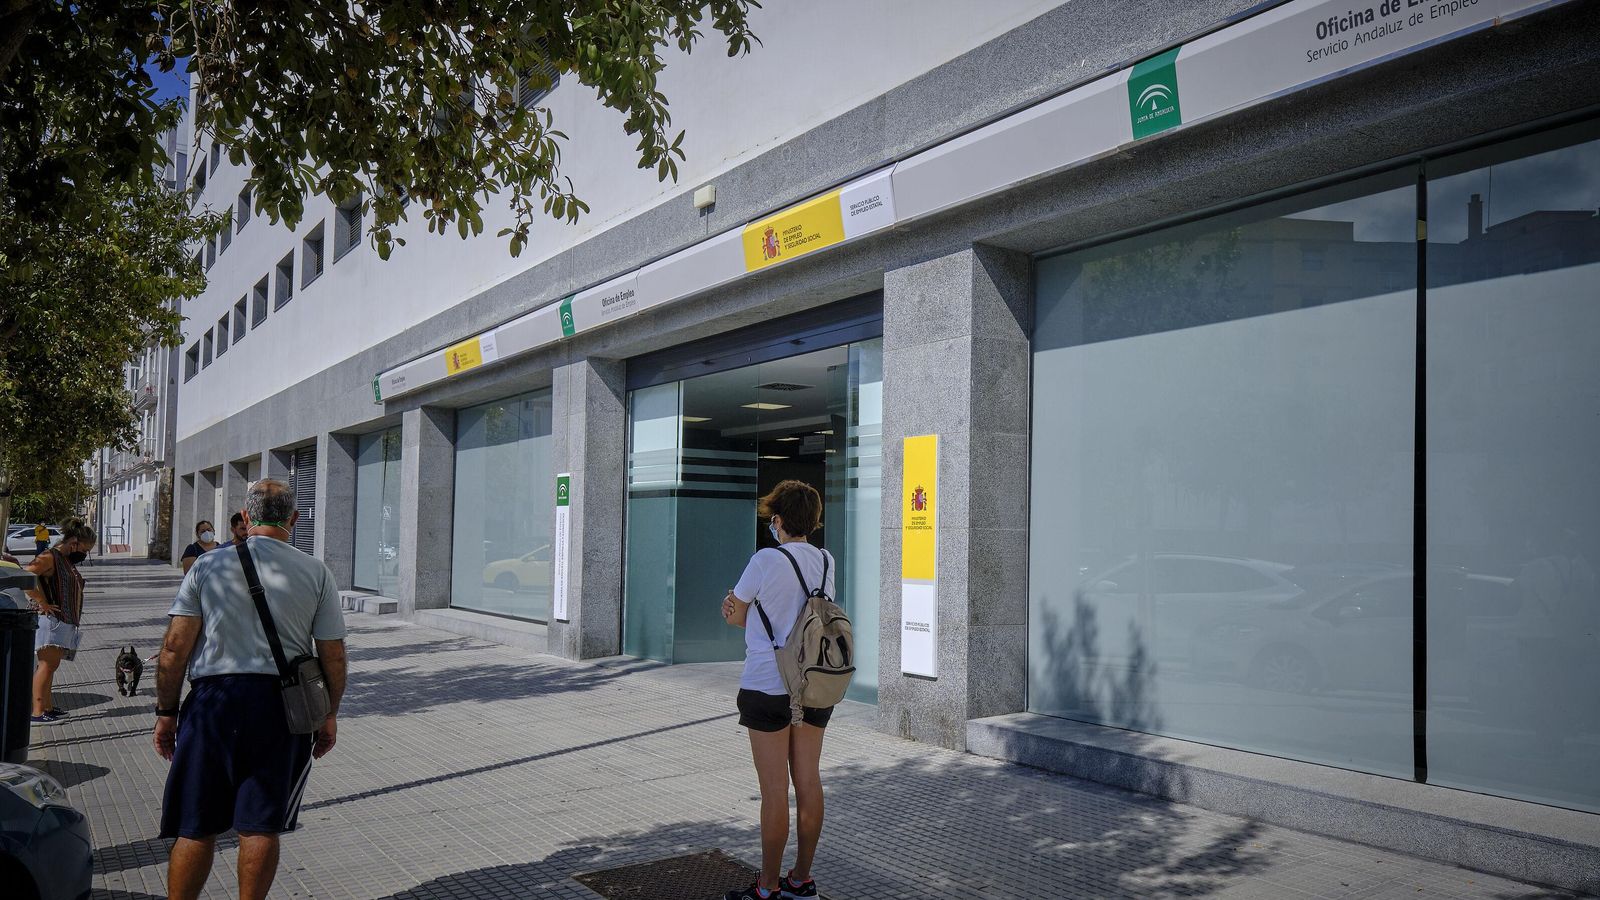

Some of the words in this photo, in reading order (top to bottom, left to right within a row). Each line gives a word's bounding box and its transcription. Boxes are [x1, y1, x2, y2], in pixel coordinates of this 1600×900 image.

[1306, 39, 1349, 63] Servicio
[1353, 19, 1403, 47] Andaluz
[1408, 12, 1424, 27] de
[1315, 7, 1375, 40] Oficina
[1379, 0, 1401, 18] de
[602, 297, 615, 307] Oficina
[620, 290, 634, 300] Empleo
